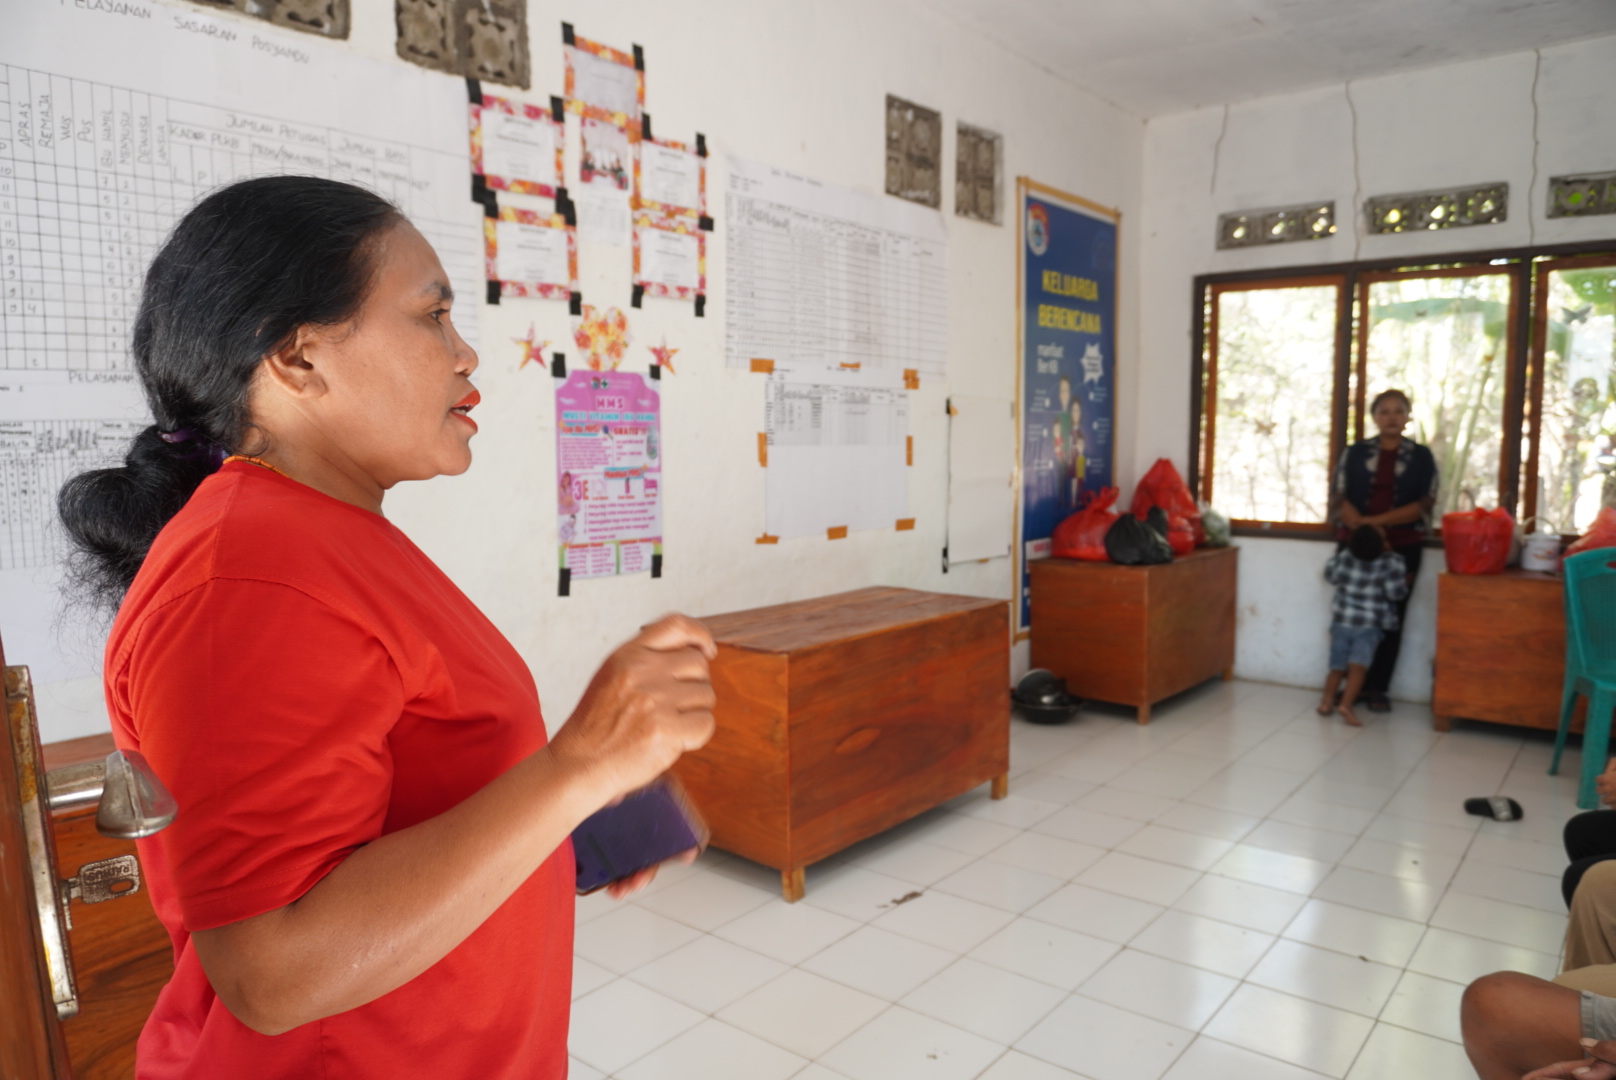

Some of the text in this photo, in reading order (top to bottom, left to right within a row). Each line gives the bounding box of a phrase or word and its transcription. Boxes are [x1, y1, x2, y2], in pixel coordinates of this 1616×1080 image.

[173, 16, 237, 42] SASARAN
[251, 35, 309, 64] POSYANDU
[18, 101, 32, 149] APRAS
[38, 94, 54, 150] REMAJA
[77, 120, 94, 143] PUS
[1042, 269, 1098, 301] KELUARGA
[1038, 303, 1102, 334] BERENCANA
[69, 370, 134, 384] PELAYANAN
[589, 412, 620, 421] VITAMIN
[596, 396, 625, 410] MMS
[614, 426, 639, 435] GRATIS
